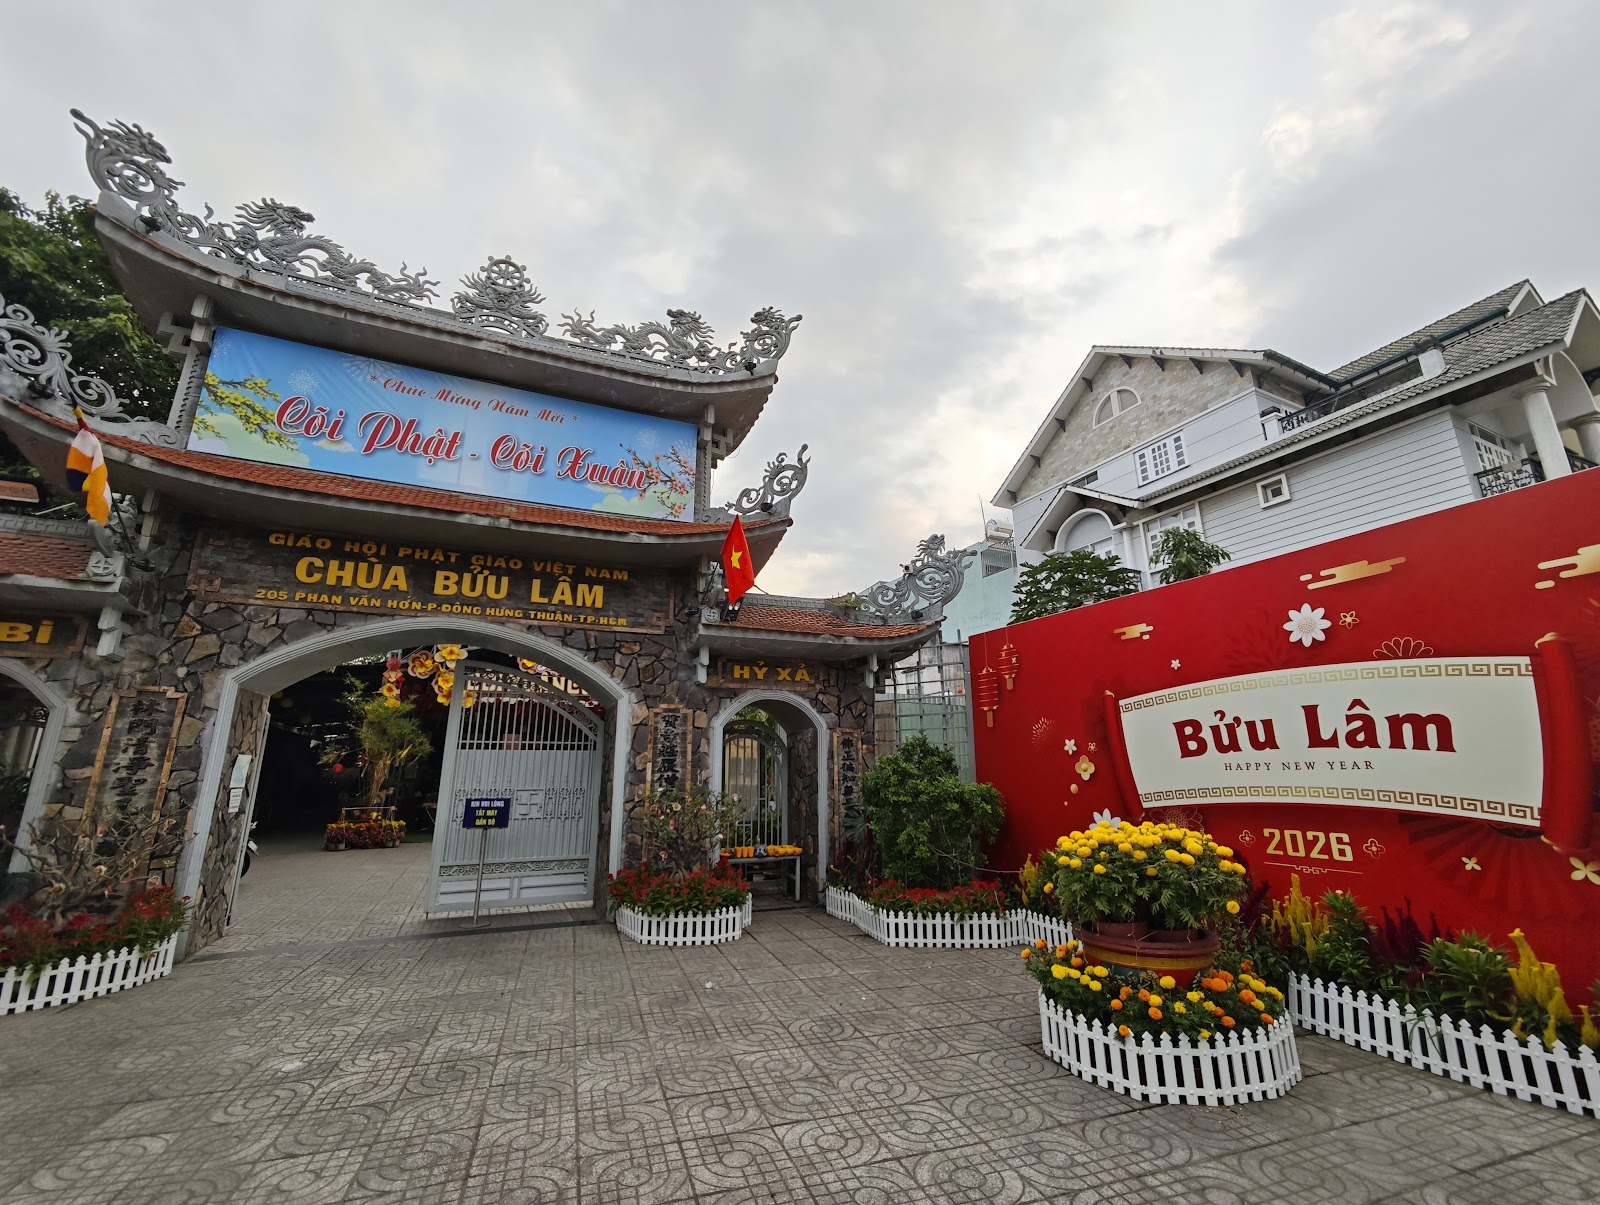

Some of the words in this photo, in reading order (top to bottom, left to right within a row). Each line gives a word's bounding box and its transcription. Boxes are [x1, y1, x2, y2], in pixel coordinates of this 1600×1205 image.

[383, 378, 427, 397] Chúc
[431, 388, 482, 410] Mừng
[488, 399, 529, 417] Năm
[534, 408, 566, 424] Mới
[275, 396, 344, 440] Cõi
[358, 411, 461, 464] Phật
[490, 434, 545, 474] Cõi
[556, 446, 647, 490] Xuân
[398, 546, 461, 565] PHẬT
[585, 567, 629, 580] NAM
[296, 555, 408, 592] CHÙA
[434, 565, 509, 600] BỬU
[530, 575, 604, 609] LÂM
[255, 589, 288, 600] 205
[295, 592, 342, 604] PHAN
[349, 594, 381, 607] VĂN
[486, 607, 523, 618] HƯNG
[734, 661, 769, 680] HỶ
[777, 663, 810, 682] XẢ
[1172, 709, 1280, 759] Bửu
[1301, 699, 1457, 753] Lâm
[1224, 762, 1273, 772] HAPPY
[1282, 761, 1318, 771] NEW
[1327, 760, 1376, 771] YEAR
[1264, 828, 1354, 862] 2026
